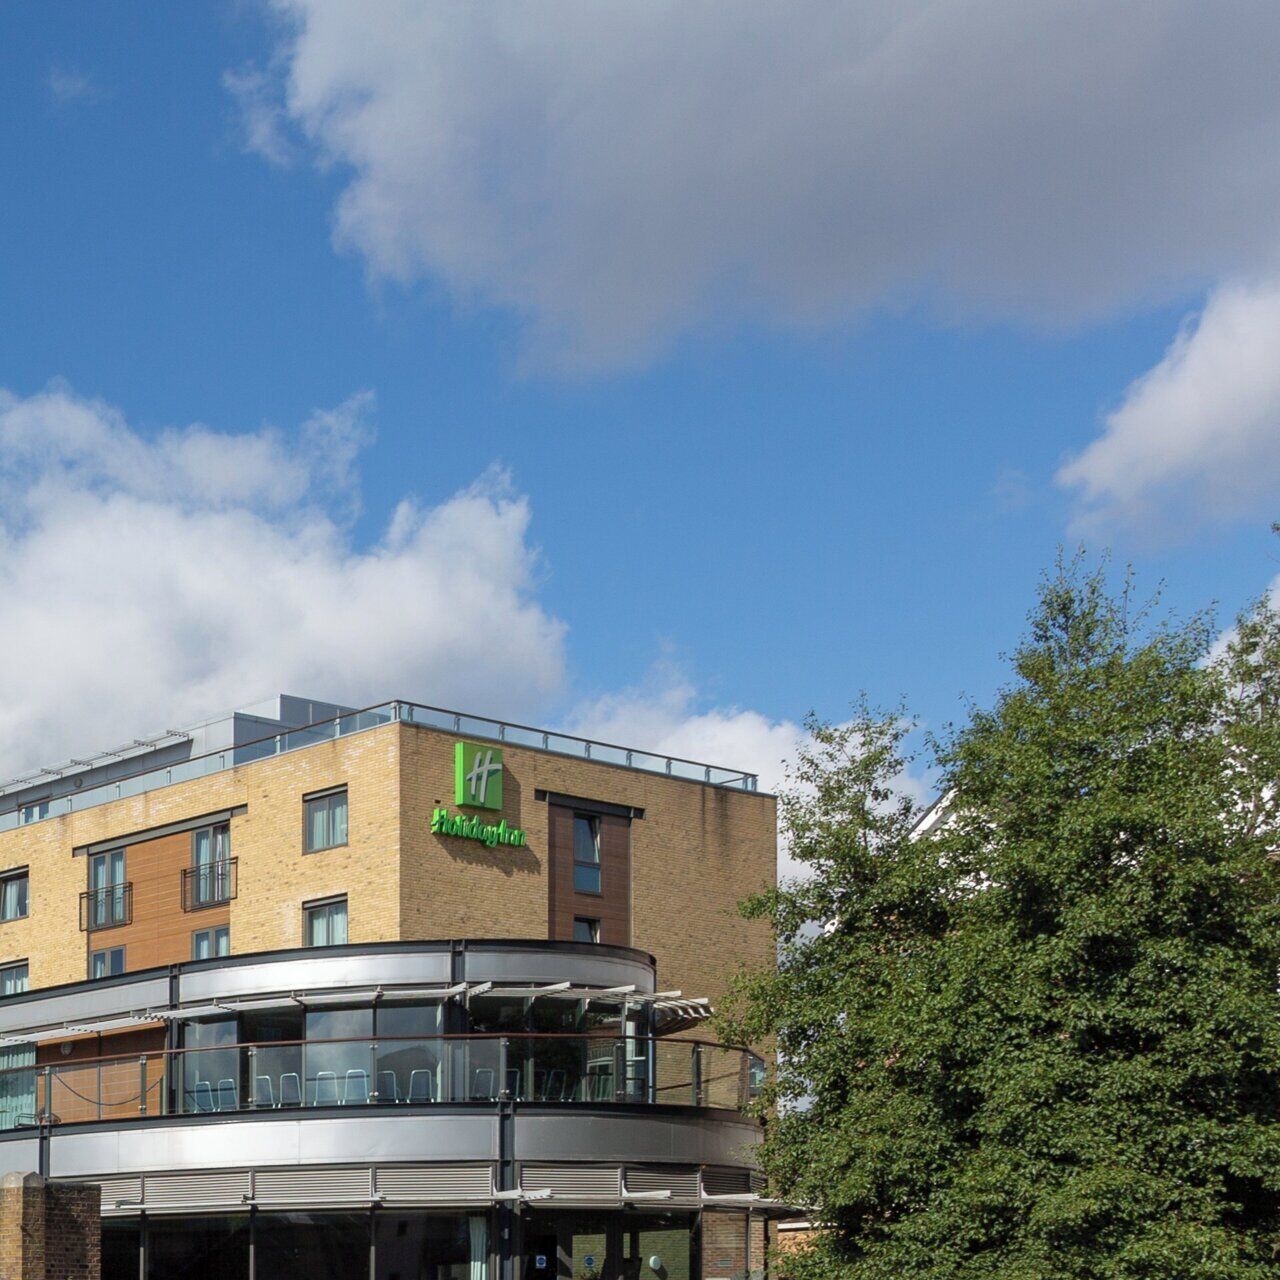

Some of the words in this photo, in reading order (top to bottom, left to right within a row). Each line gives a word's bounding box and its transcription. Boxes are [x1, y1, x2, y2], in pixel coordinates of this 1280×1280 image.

[466, 750, 502, 803] H
[431, 808, 500, 848] Holiday
[498, 819, 527, 847] Inn
